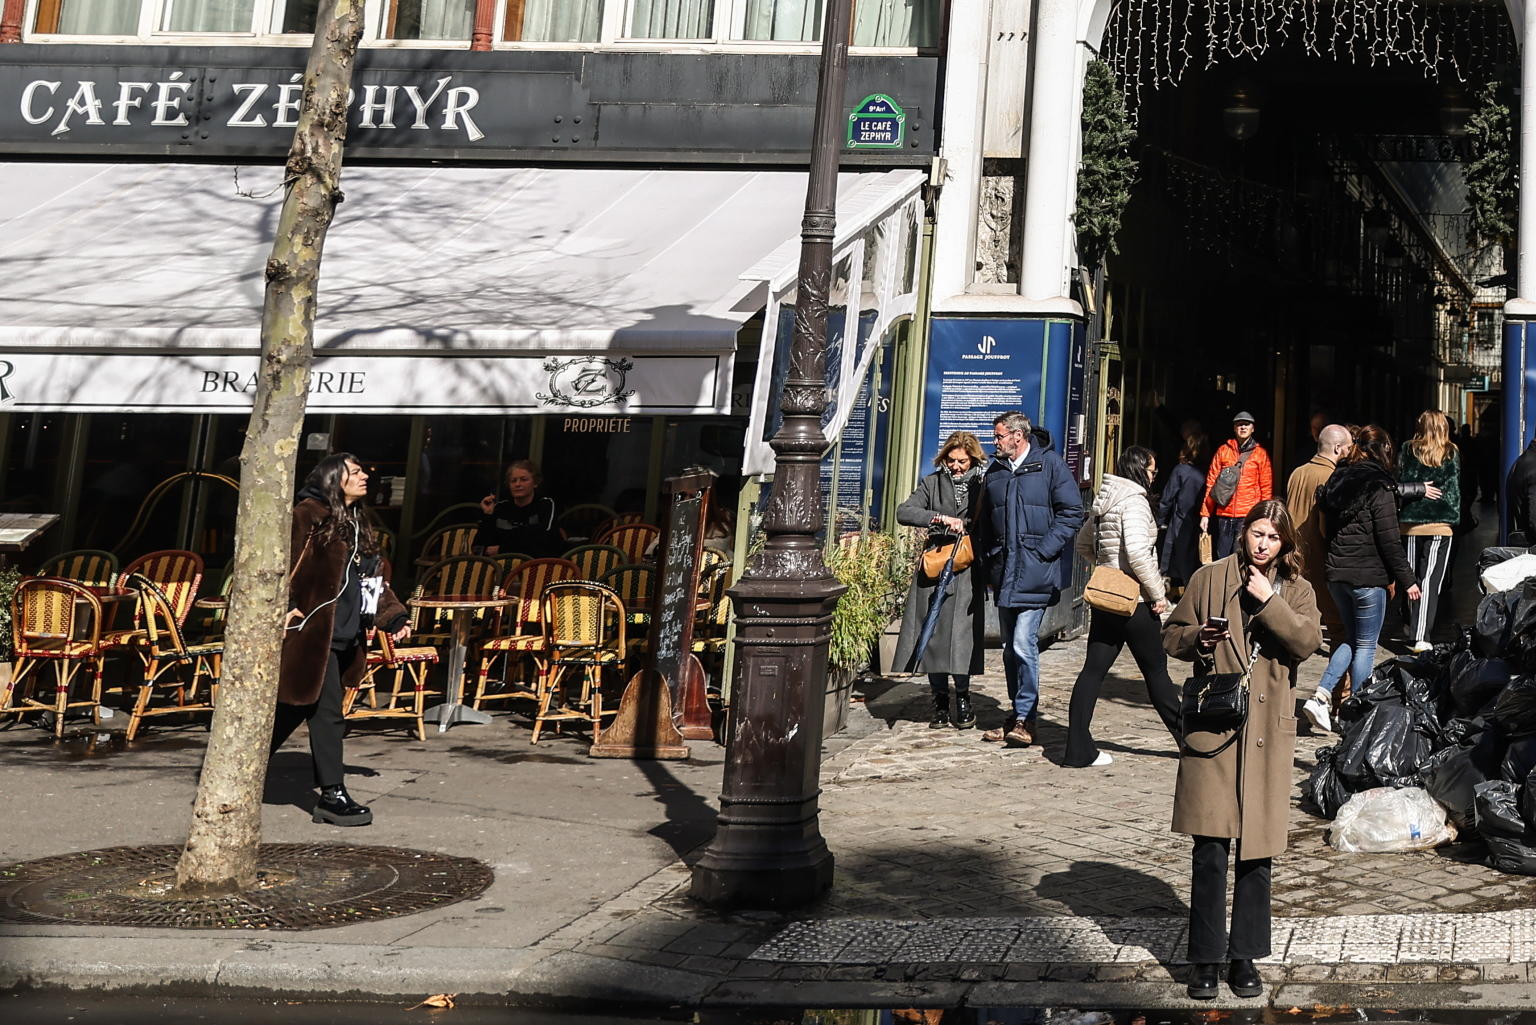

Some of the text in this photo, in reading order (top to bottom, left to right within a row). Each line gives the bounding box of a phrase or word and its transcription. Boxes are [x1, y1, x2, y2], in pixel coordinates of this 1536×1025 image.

[19, 71, 487, 142] CAFÉ ZÉHYR
[860, 120, 892, 131] LE CAFÉ
[860, 131, 892, 141] ZEPHYR
[200, 370, 366, 394] BRARIE
[563, 416, 631, 433] PROPRIÉTÉ
